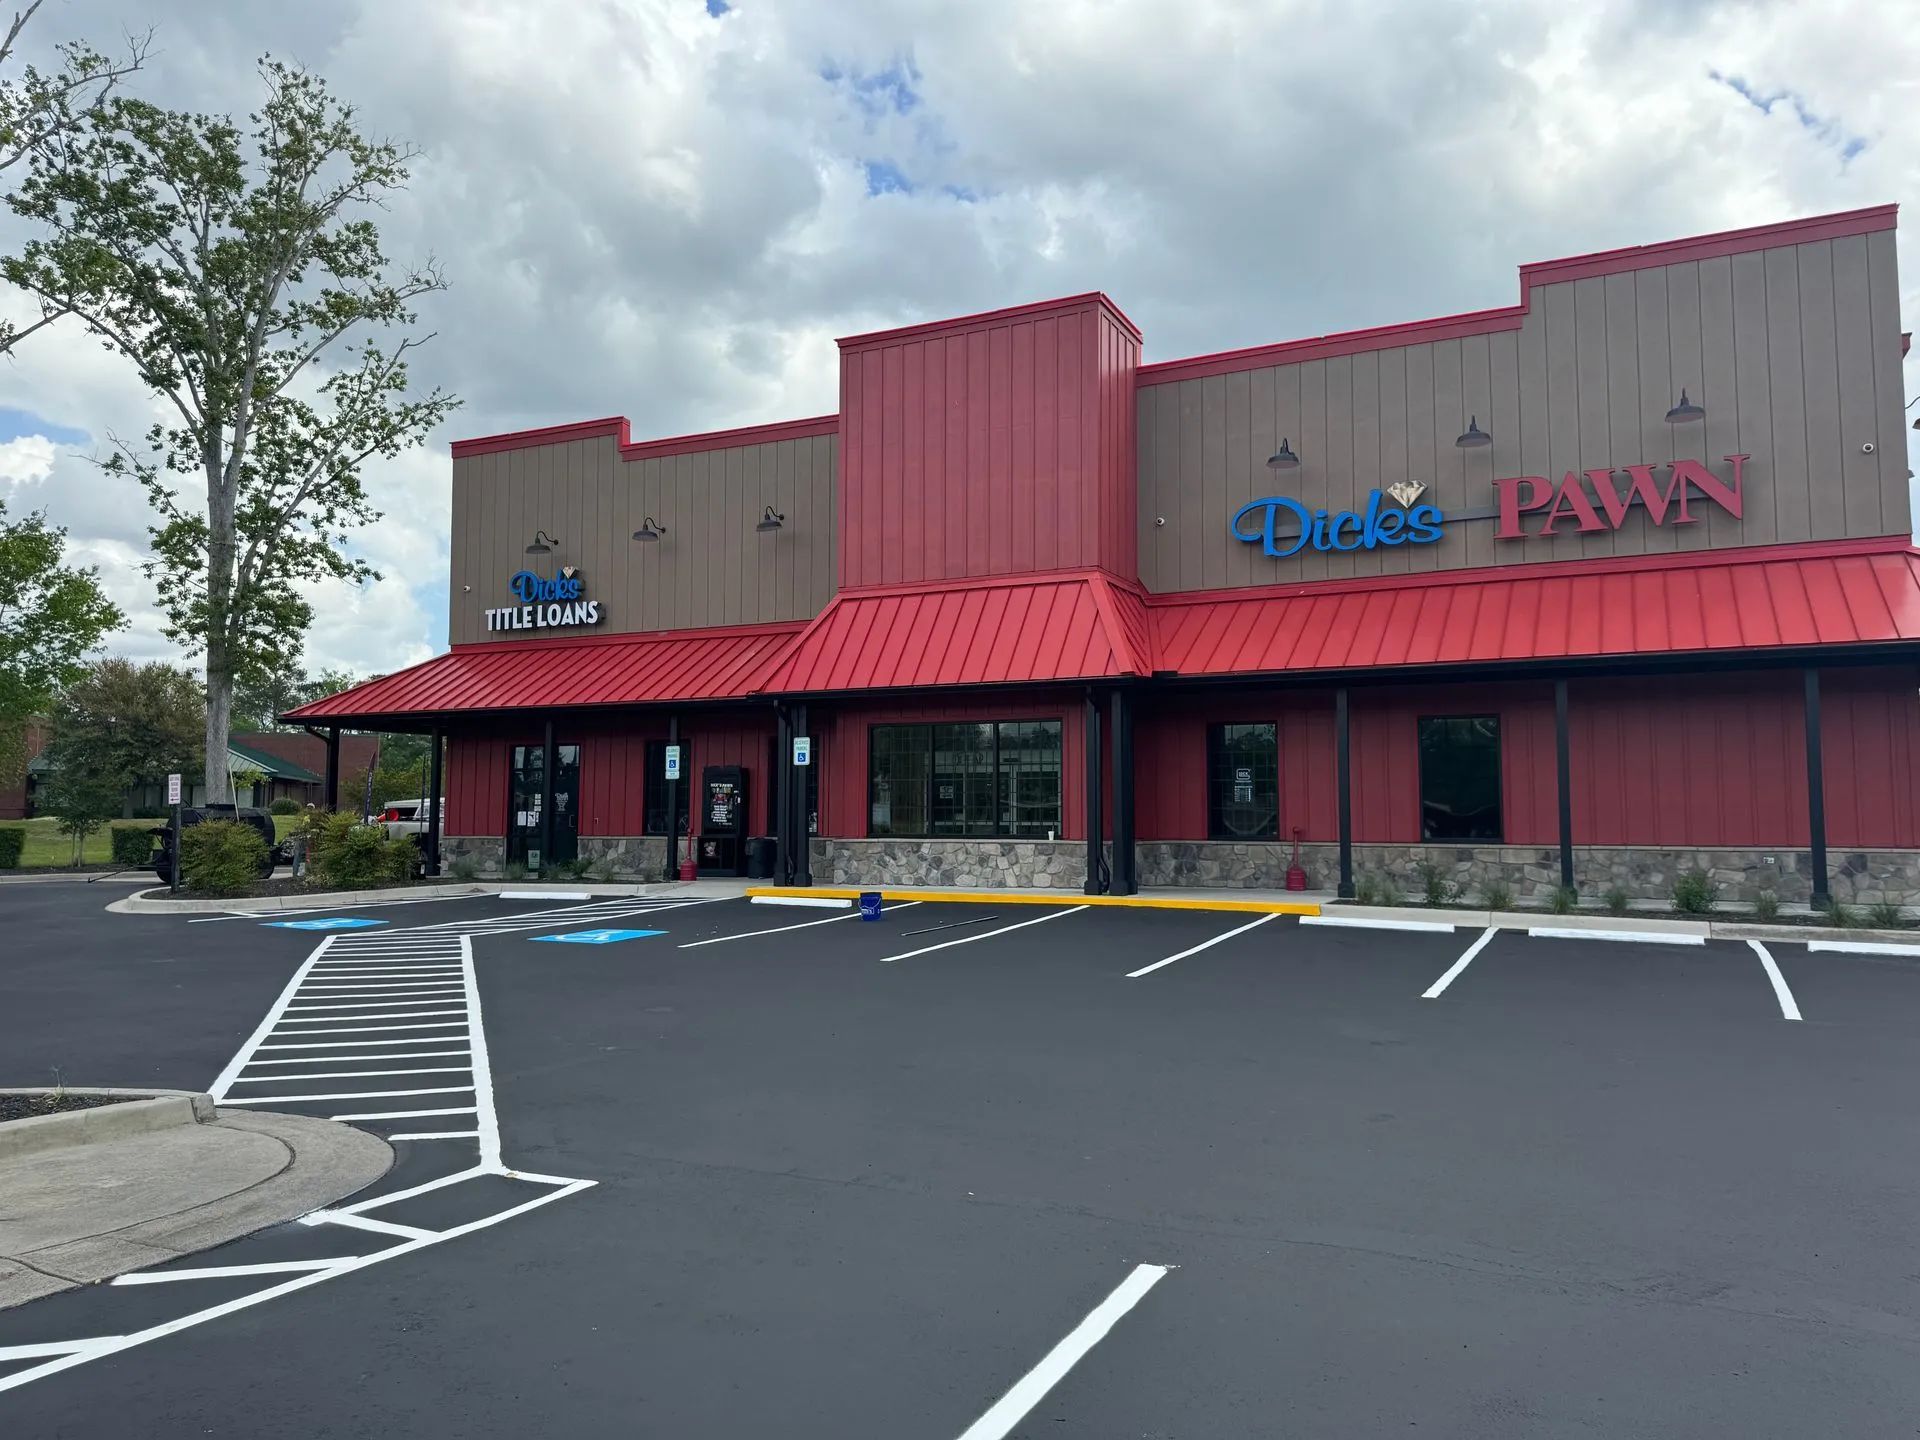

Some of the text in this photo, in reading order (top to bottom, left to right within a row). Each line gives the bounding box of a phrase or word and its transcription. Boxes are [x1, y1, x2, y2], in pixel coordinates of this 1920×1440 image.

[1491, 453, 1752, 540] PAWN
[485, 600, 599, 631] TITLE LOANS
